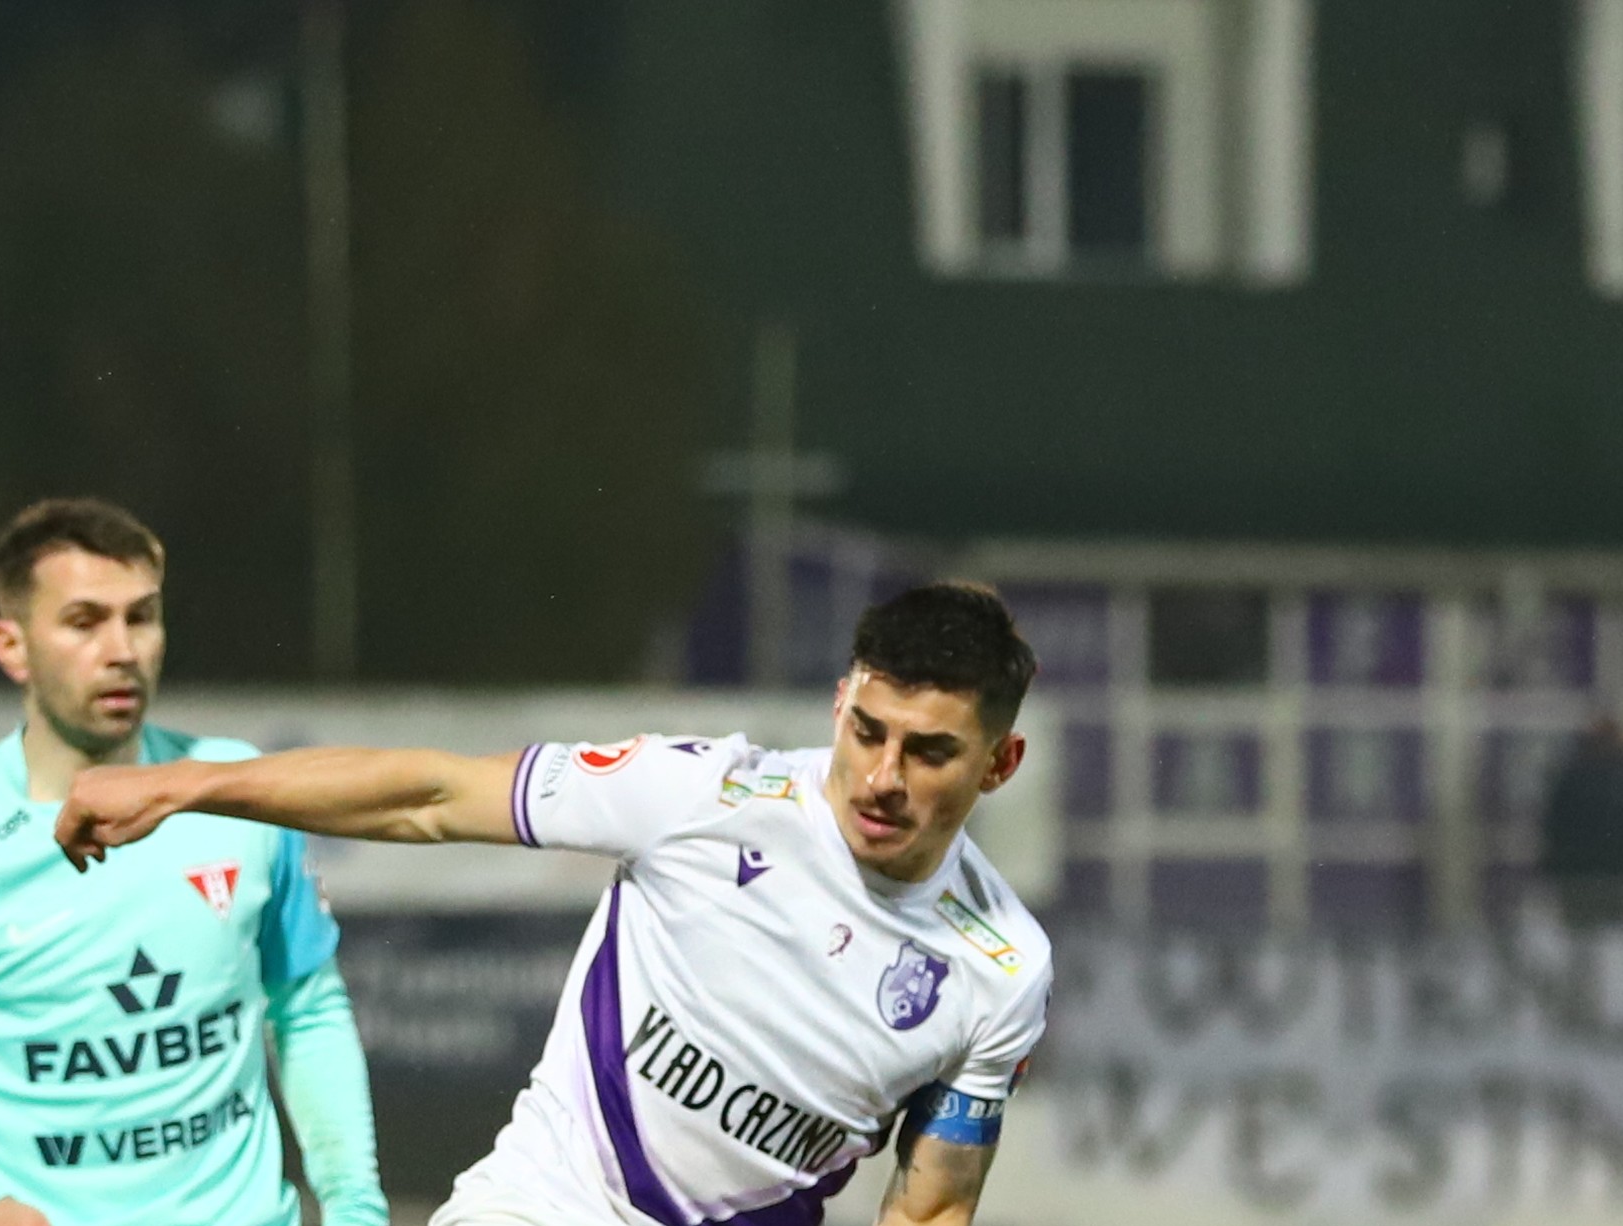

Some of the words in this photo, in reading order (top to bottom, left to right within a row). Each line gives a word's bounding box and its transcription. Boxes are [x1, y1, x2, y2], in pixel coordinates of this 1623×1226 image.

[24, 1001, 244, 1084] FAVBET
[624, 1002, 726, 1111] VLAD
[719, 1082, 848, 1175] CAZINO
